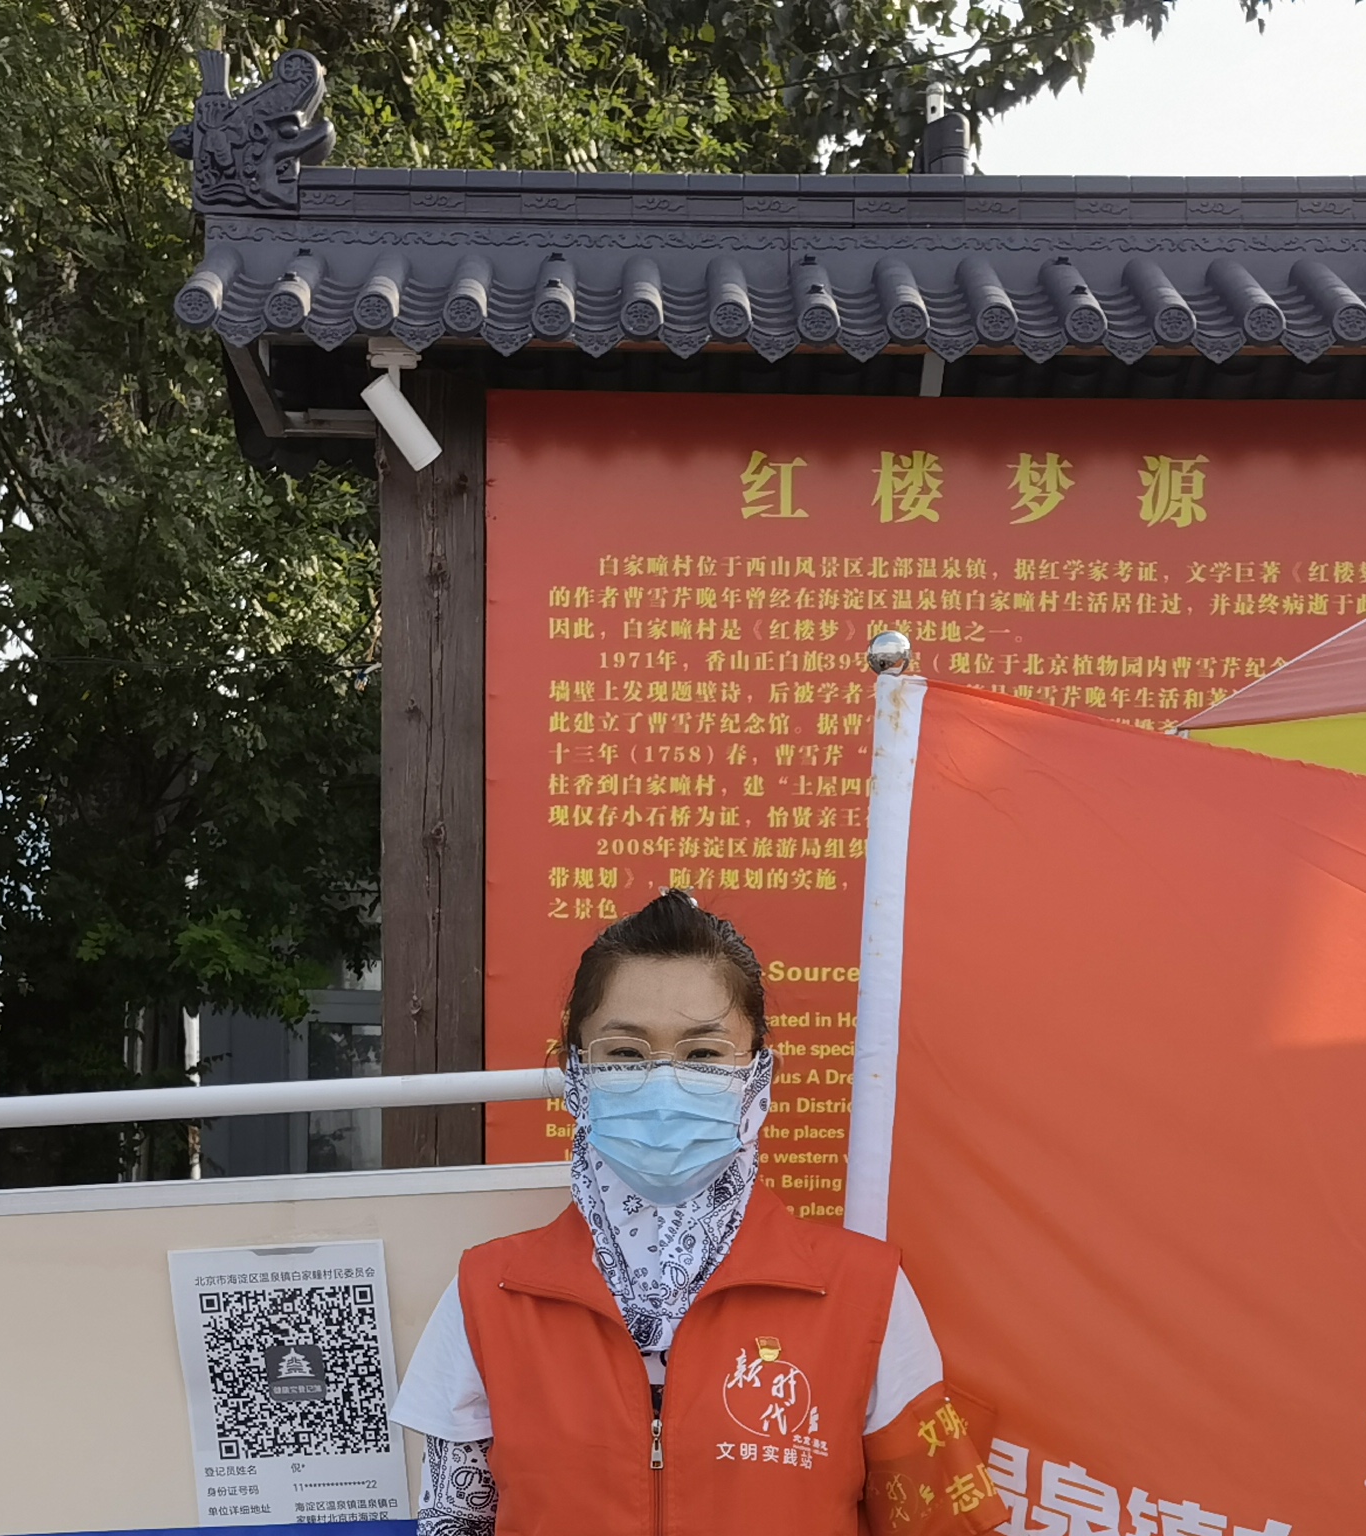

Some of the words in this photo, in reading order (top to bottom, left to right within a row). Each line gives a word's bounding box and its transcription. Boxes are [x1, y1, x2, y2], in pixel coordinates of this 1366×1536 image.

[739, 449, 1212, 530] 红楼梦源
[548, 711, 875, 738] 此建立了曹雪芹纪念馆。据曹
[547, 805, 871, 830] 现仅存小石桥为证，怡贤亲王
[815, 1011, 833, 1028] in
[778, 1040, 807, 1057] the
[806, 1069, 821, 1085] A
[763, 1125, 790, 1140] the
[793, 1125, 846, 1143] places
[773, 1150, 839, 1165] western
[781, 1174, 843, 1193] Beijing
[715, 1440, 814, 1471] 文明实践站
[204, 1464, 258, 1478] 登记员姓名
[206, 1484, 260, 1498] 身份证号码
[208, 1503, 272, 1517] 单位详细地址
